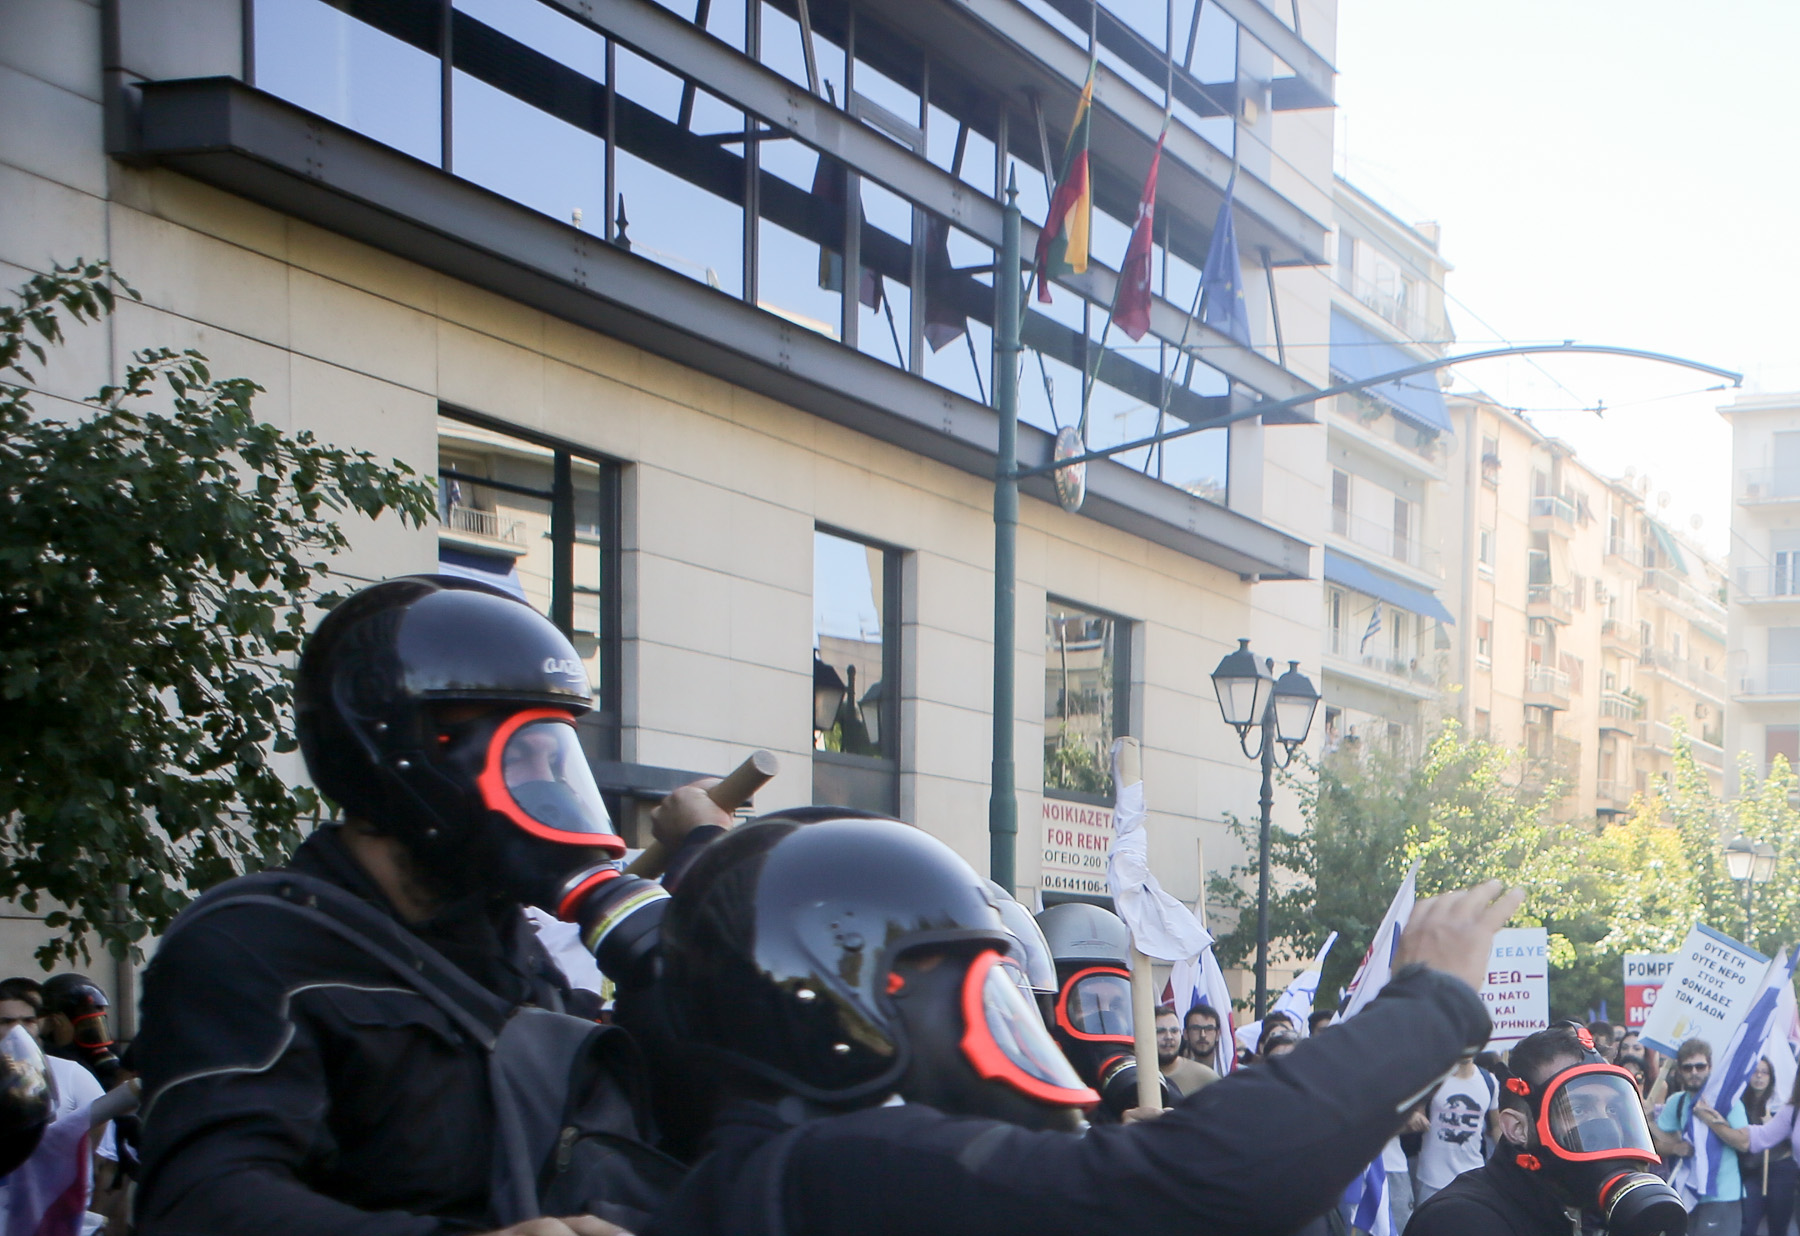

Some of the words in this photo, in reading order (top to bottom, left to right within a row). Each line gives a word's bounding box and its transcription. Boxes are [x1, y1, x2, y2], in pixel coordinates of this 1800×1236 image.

[1042, 803, 1114, 829] ΝΟΙΚΙΑΖΕΤ
[1048, 828, 1073, 847] FOR
[1077, 832, 1109, 852] RENT
[1041, 848, 1080, 866] ΟΓΕΙΟ
[1083, 854, 1102, 868] 200
[1041, 874, 1108, 894] 10.6141106-1
[1496, 946, 1545, 958] ΕΕΔΥΕ
[1704, 942, 1732, 959] ΟΥΤΕ
[1731, 956, 1747, 969] ΓΗ
[1488, 970, 1521, 985] ΕΞΩ
[1692, 952, 1716, 970] ΟΥΤΕ
[1719, 965, 1746, 985] ΝΕΡΟ
[1698, 970, 1726, 989] ΣΤΟΥΣ
[1499, 991, 1530, 1001] ΝΑΤΟ
[1642, 987, 1660, 1005] G
[1681, 977, 1733, 1008] ΦΟΝΙΑΔΕΣ
[1495, 1006, 1515, 1015] ΚΑΙ
[1675, 989, 1695, 1005] ΤΩΝ
[1696, 1001, 1726, 1021] ΛΑΩΝ
[1493, 1019, 1546, 1029] ΥΡΗΝΙΚΑ
